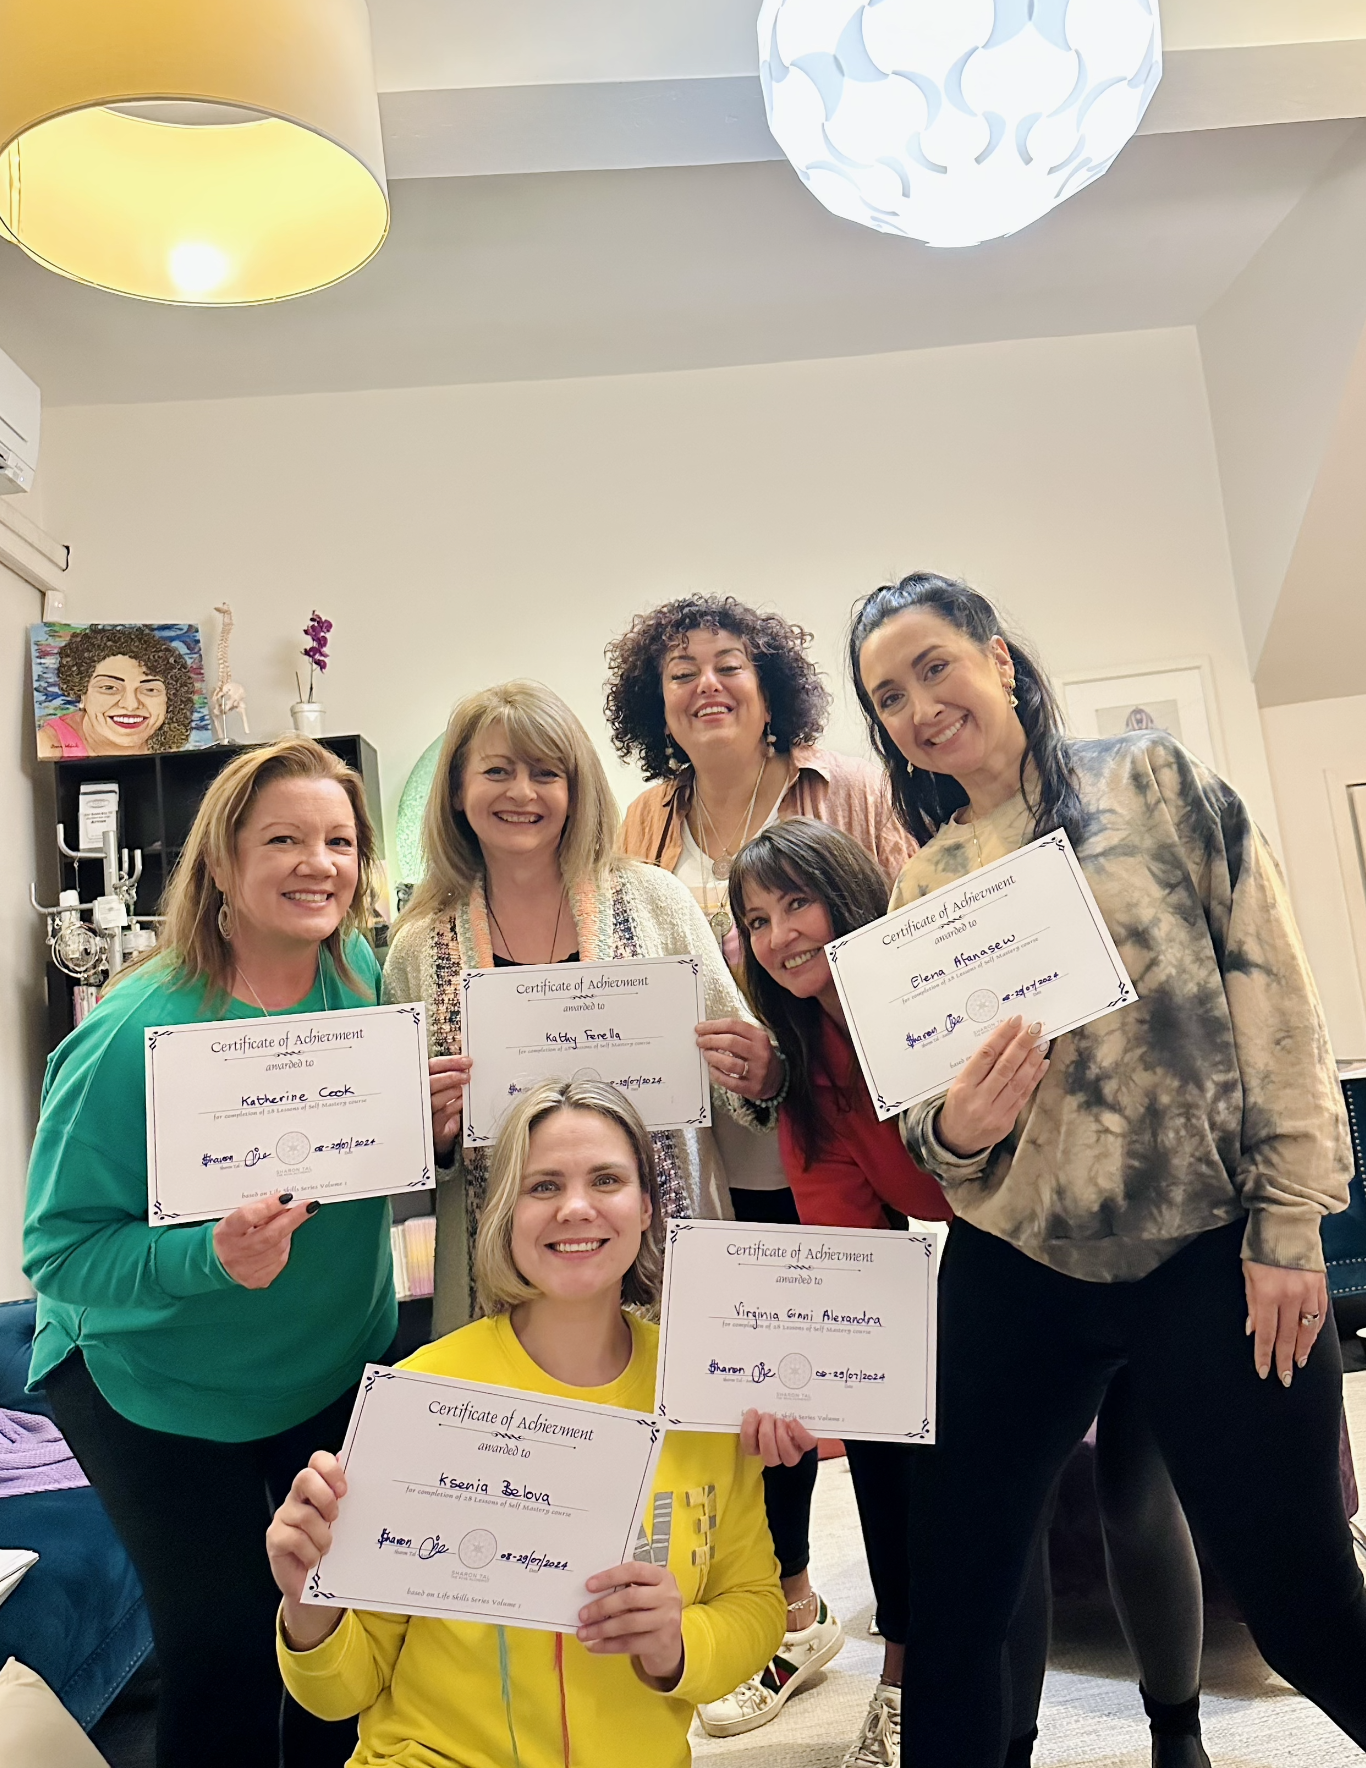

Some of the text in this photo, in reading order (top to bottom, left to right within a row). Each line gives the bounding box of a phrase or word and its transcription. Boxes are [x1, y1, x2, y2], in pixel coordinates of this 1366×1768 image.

[882, 874, 1016, 946] Certificate of Achievment
[934, 919, 977, 945] awarded to
[911, 969, 946, 988] Elena
[912, 983, 940, 1000] completion
[956, 966, 977, 979] Lessons
[984, 957, 994, 966] Self
[996, 946, 1020, 960] Mastery
[516, 975, 650, 996] Certificate of Achievment
[563, 1002, 605, 1013] awarded to
[211, 1028, 365, 1054] Certificate of Achievment
[546, 1032, 577, 1050] Kathy
[266, 1059, 314, 1072] awarded to
[241, 1084, 356, 1107] Katherine Cook
[224, 1110, 258, 1119] completion
[308, 1102, 320, 1110] Self
[321, 1100, 347, 1108] Mastery
[242, 1191, 259, 1199] based
[300, 1184, 318, 1192] Series
[726, 1240, 874, 1262] Certificate of Achievment
[776, 1274, 823, 1285] awarded to
[734, 1302, 883, 1330] Virginia Ginni Alexandra
[428, 1400, 594, 1442] Certificate of Achievment
[478, 1441, 531, 1459] awarded to
[439, 1472, 551, 1506] Ksenia Belova
[406, 1486, 415, 1494] for
[418, 1488, 454, 1499] completion
[454, 1493, 462, 1501] of
[474, 1497, 499, 1506] Lessons
[500, 1500, 508, 1508] of
[508, 1502, 522, 1510] Self
[522, 1505, 550, 1515] Mastery
[551, 1510, 572, 1518] course
[407, 1587, 425, 1598] based
[437, 1592, 450, 1600] Life
[452, 1594, 470, 1602] Skills
[470, 1596, 490, 1605] Series
[492, 1598, 516, 1608] Volume
